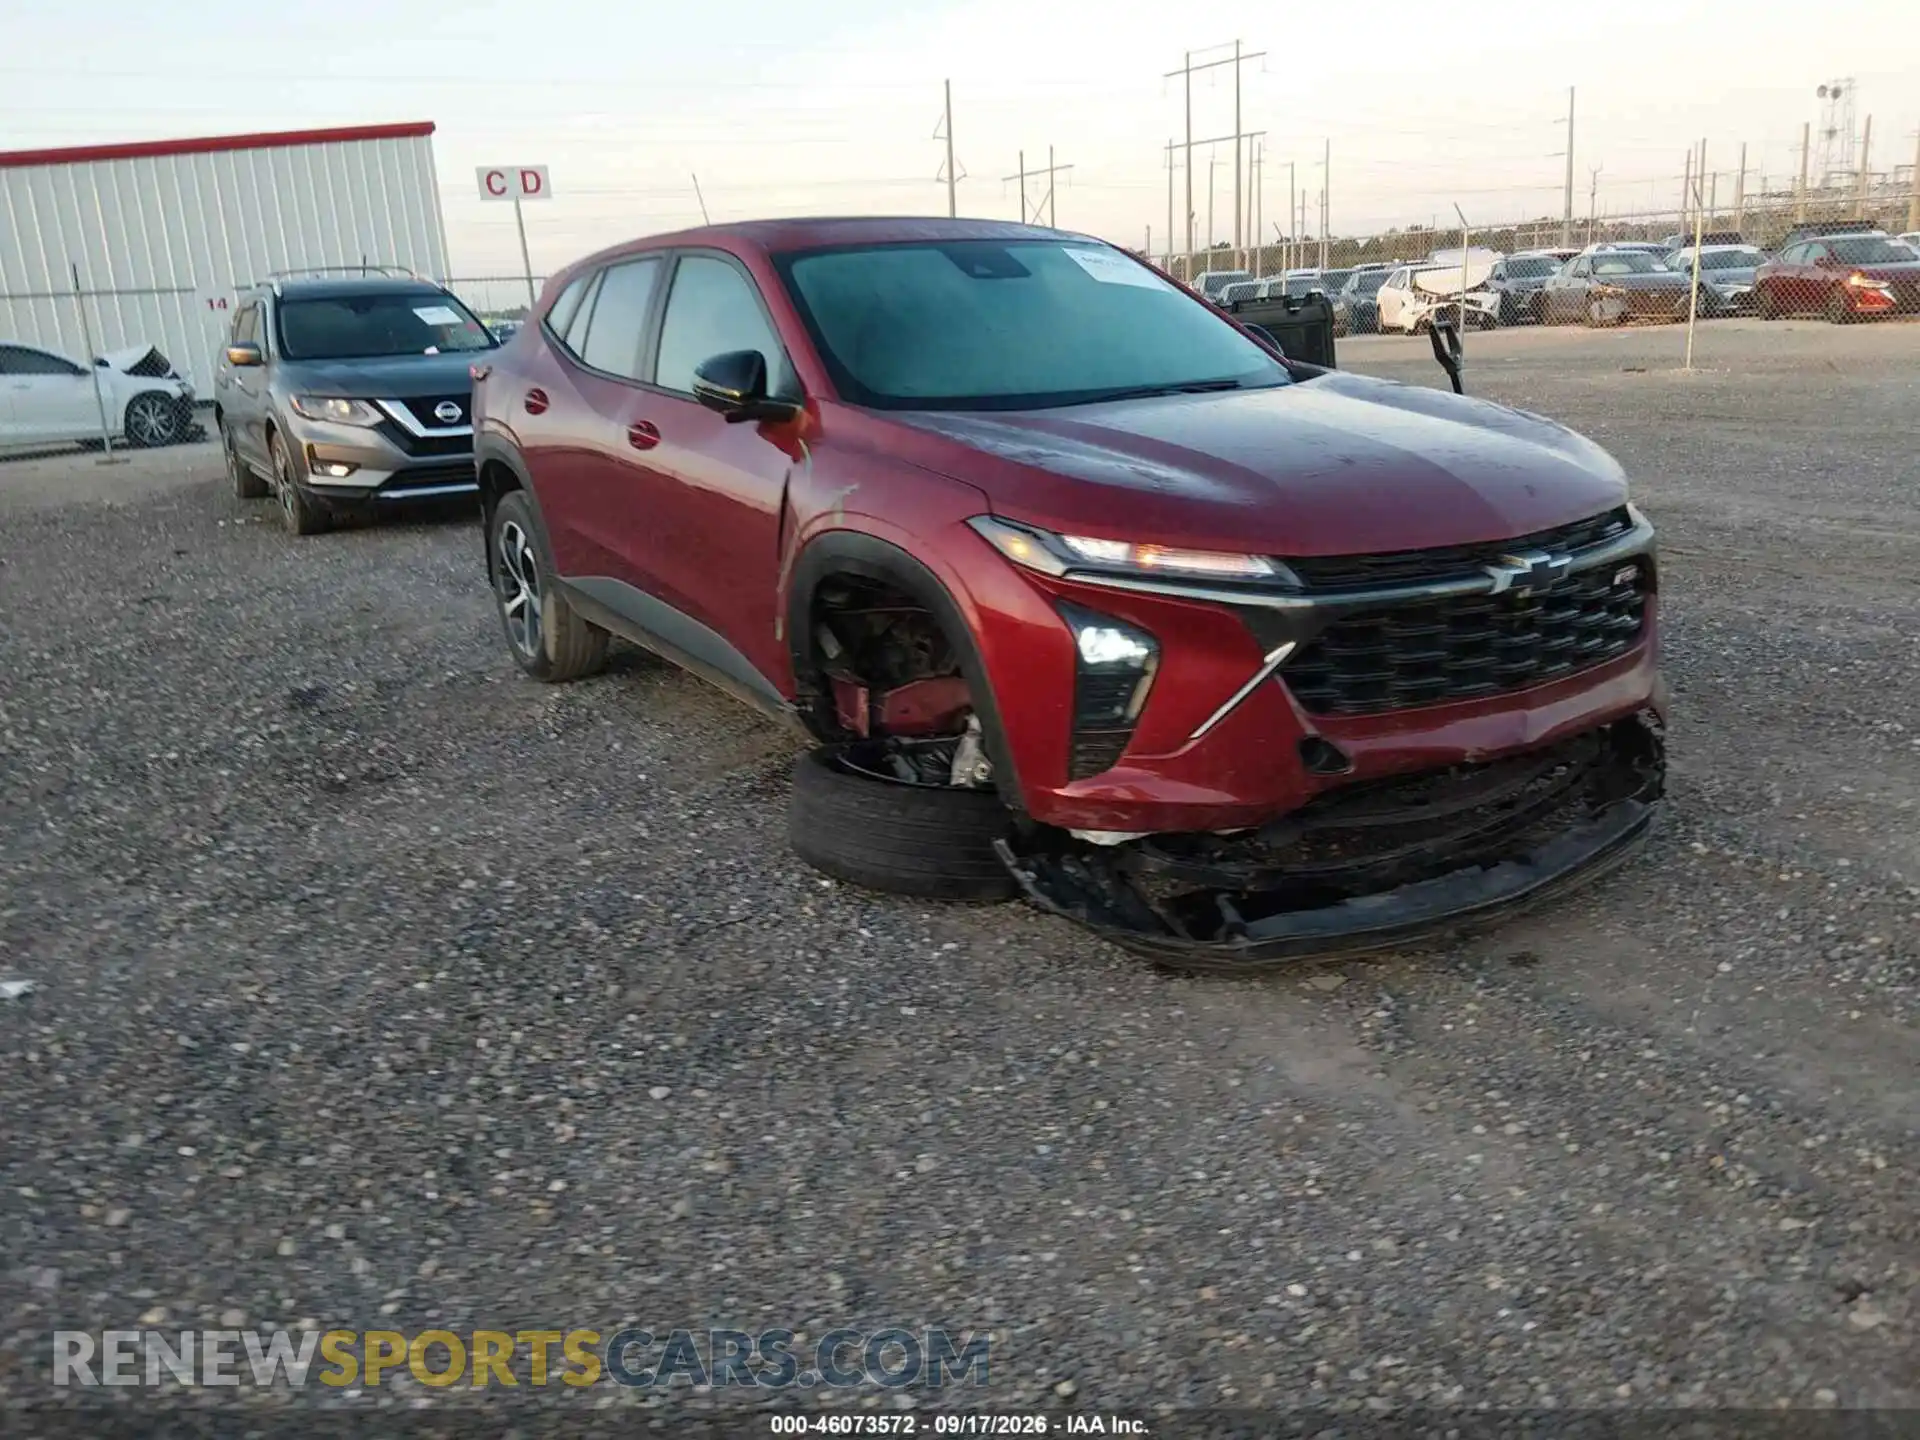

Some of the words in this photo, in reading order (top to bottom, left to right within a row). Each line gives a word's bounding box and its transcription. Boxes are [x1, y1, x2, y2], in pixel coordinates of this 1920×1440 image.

[486, 170, 507, 196] C
[520, 169, 541, 194] D
[206, 297, 227, 311] 14
